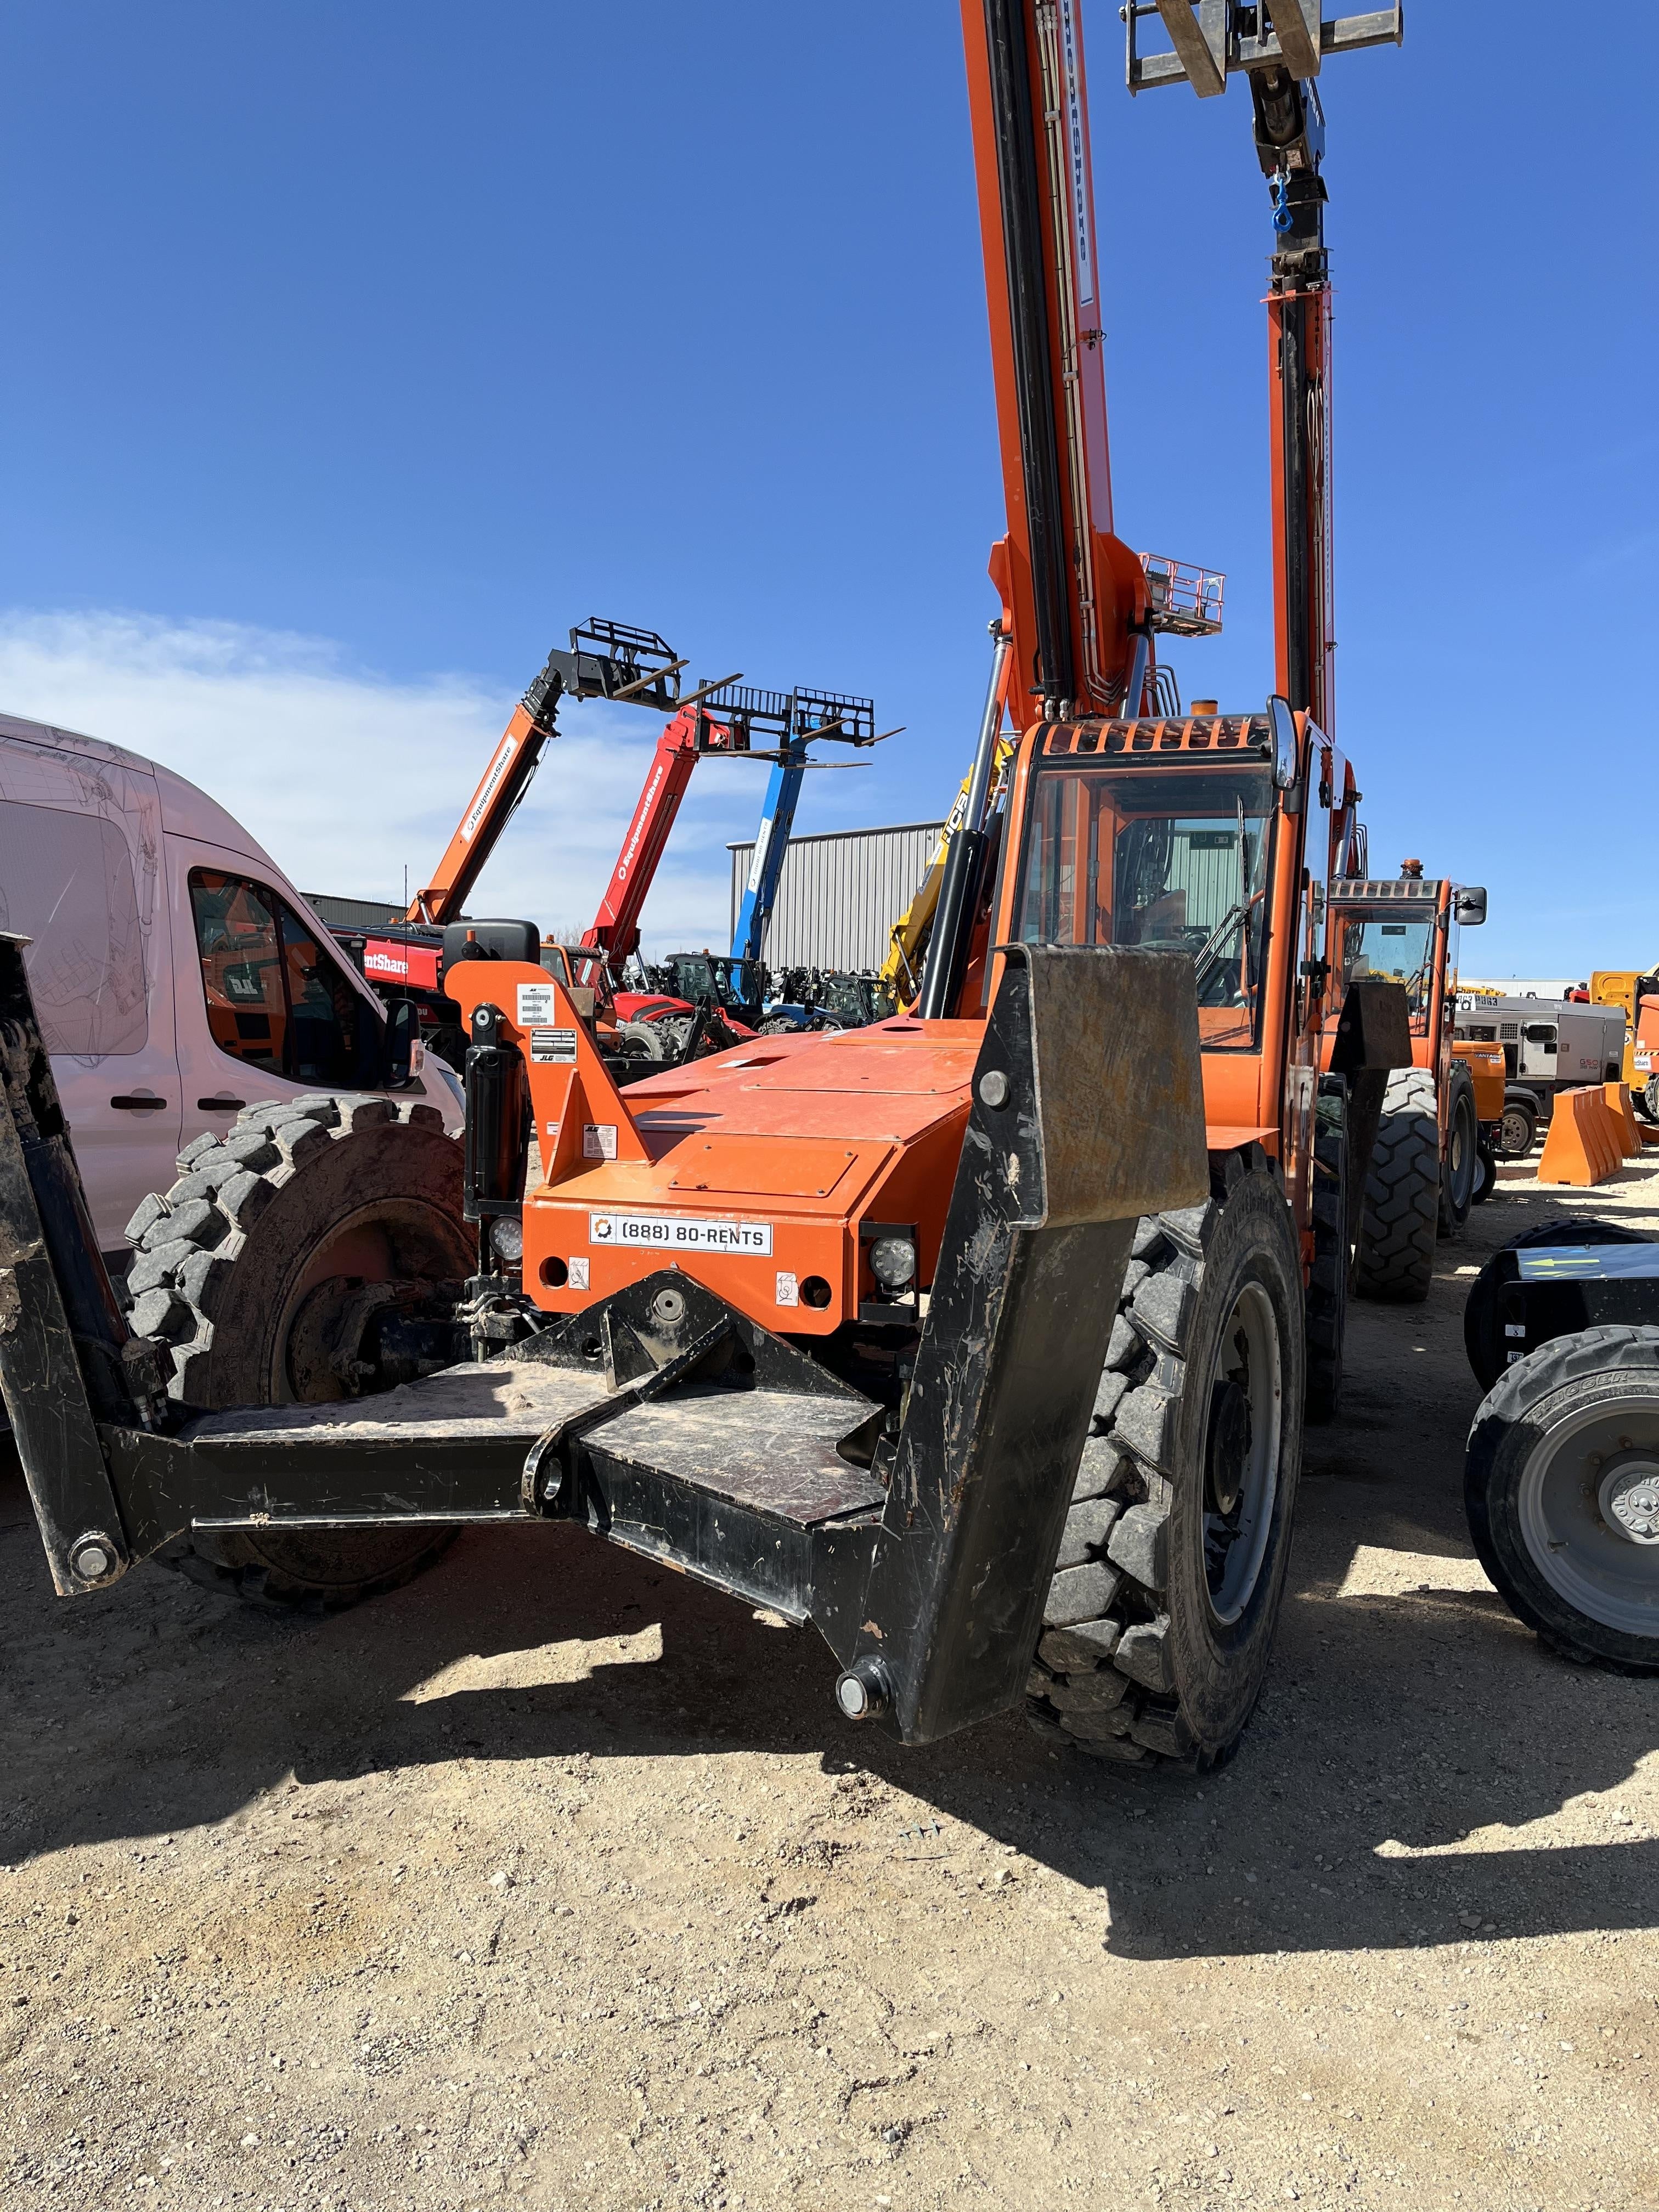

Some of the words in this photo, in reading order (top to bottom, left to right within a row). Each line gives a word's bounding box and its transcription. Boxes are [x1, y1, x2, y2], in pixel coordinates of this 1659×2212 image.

[472, 746, 511, 822] EquipmentShare
[623, 765, 663, 868] EquipmentShare
[945, 792, 968, 844] JCB
[622, 1222, 669, 1240] (888)
[676, 1227, 764, 1246] 80-RENTS
